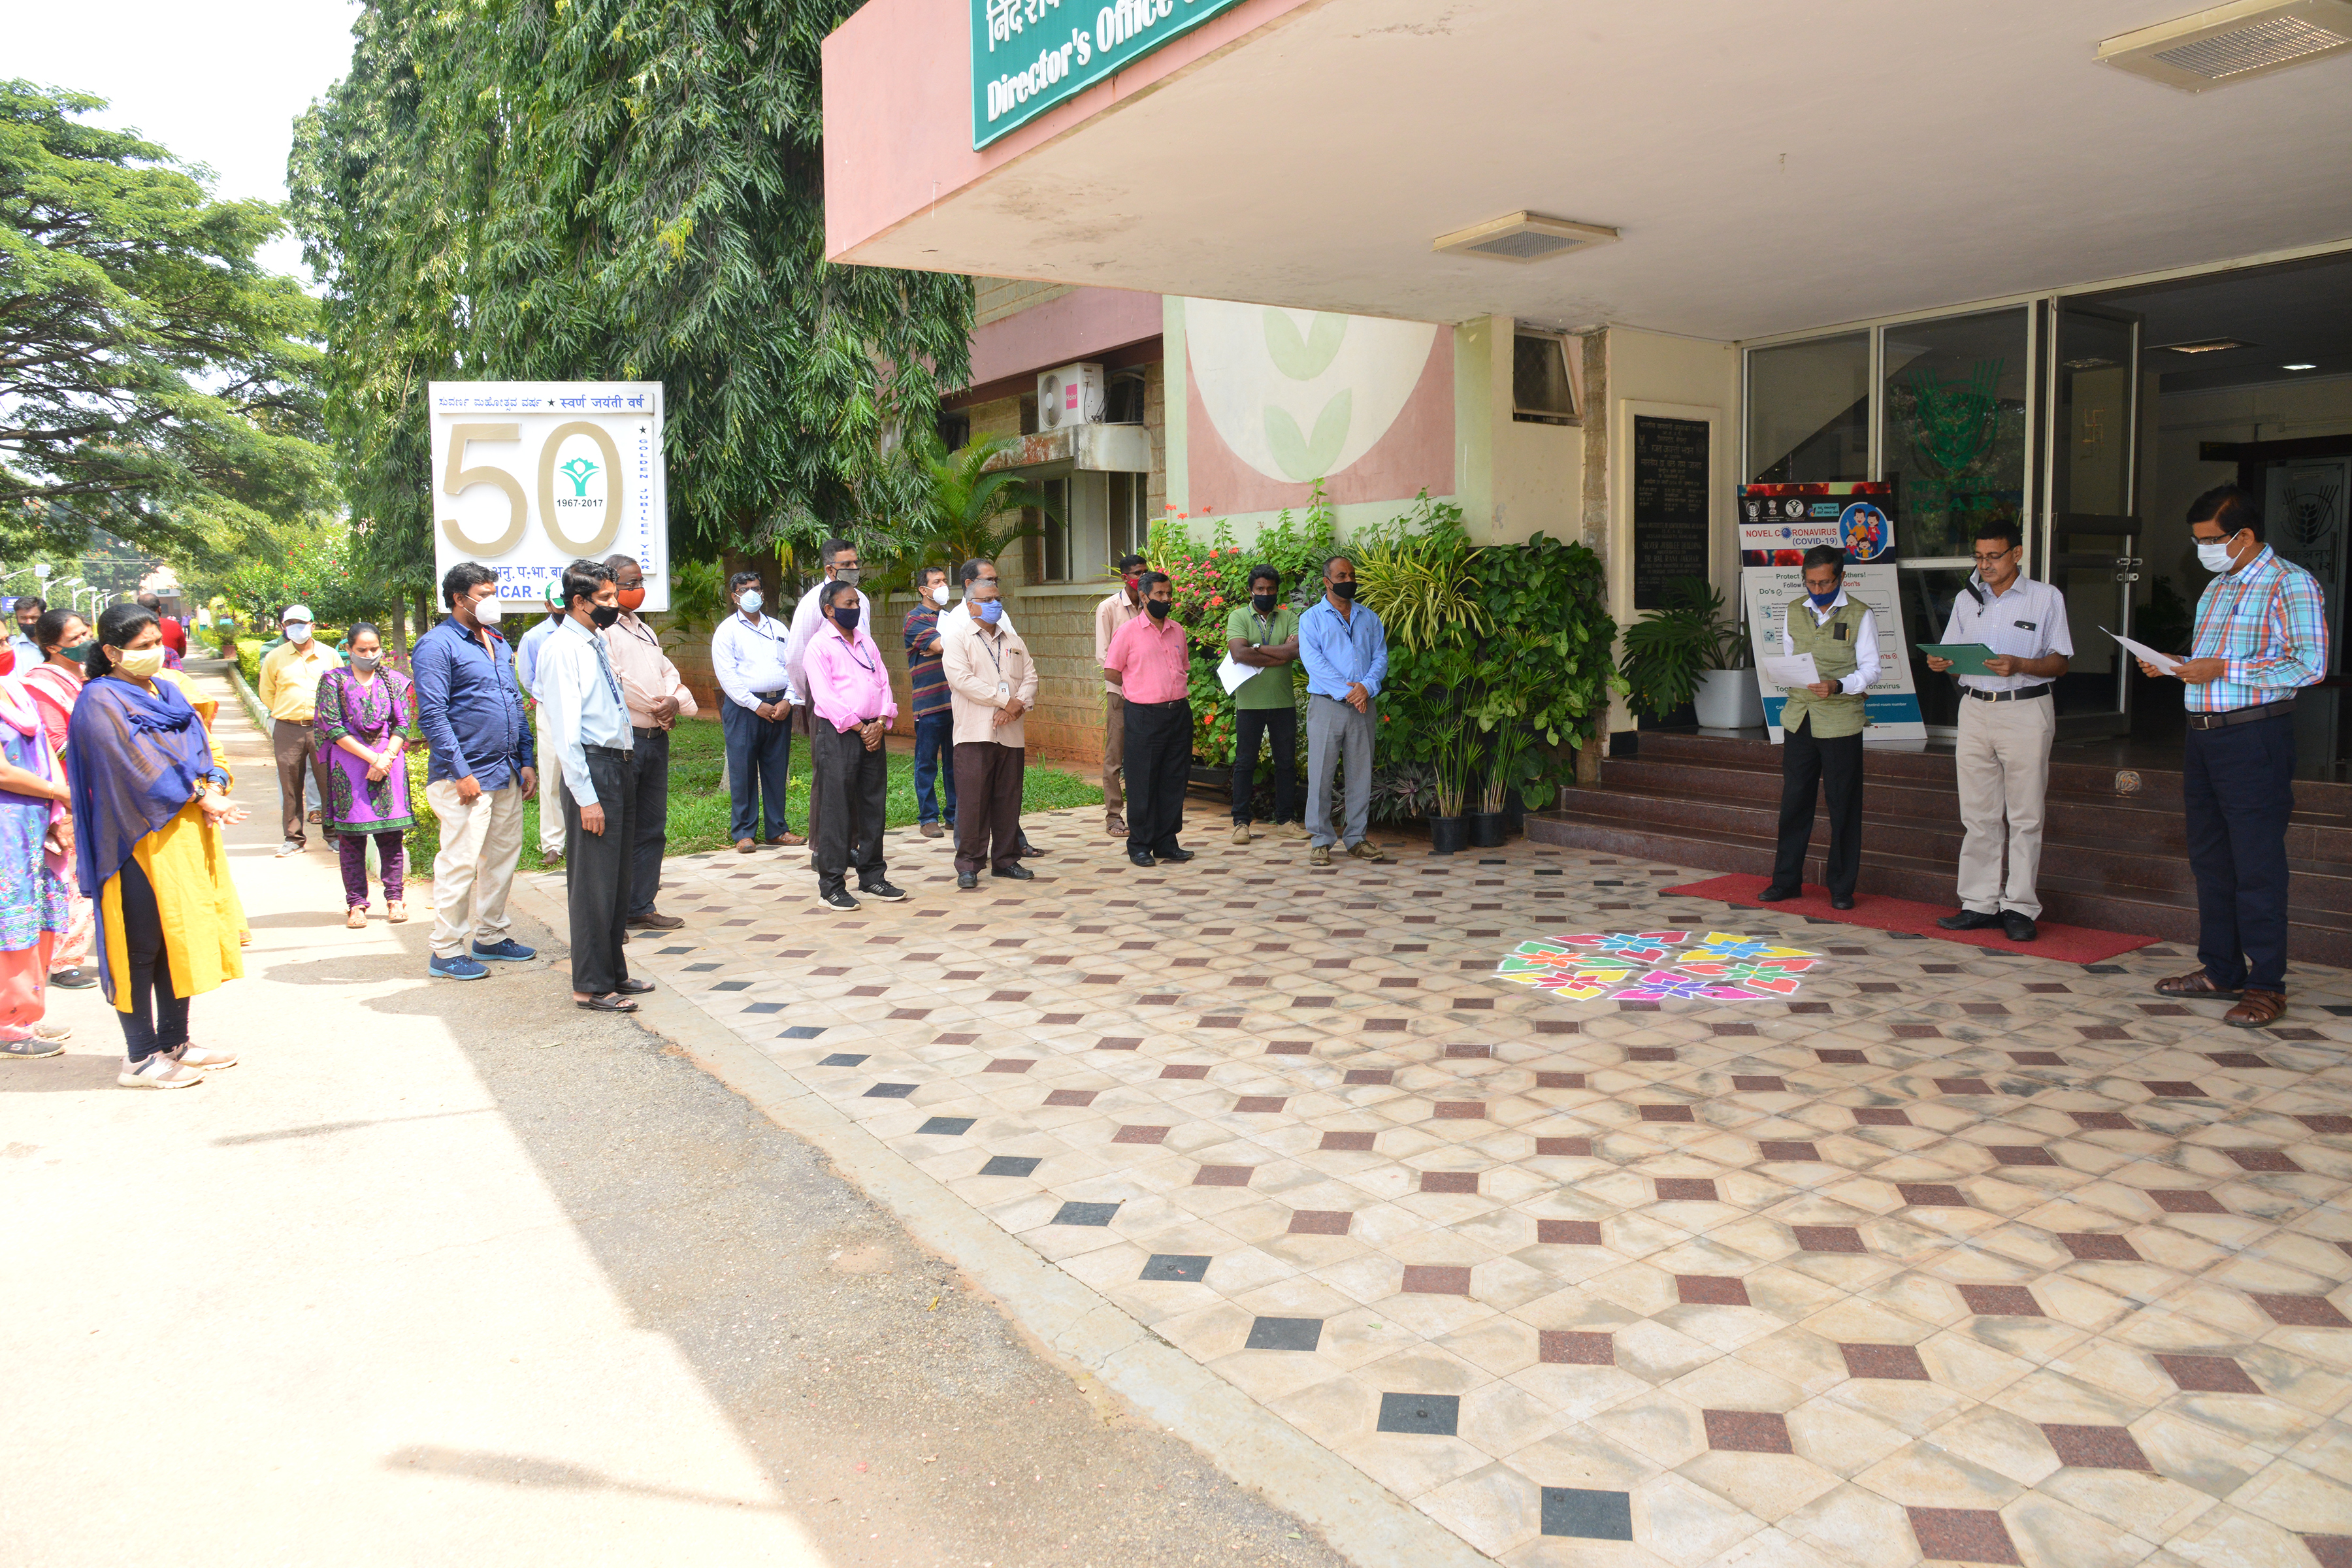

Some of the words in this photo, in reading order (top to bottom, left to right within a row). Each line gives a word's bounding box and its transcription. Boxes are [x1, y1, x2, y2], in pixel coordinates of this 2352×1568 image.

[987, 27, 1091, 123] Director's
[1096, 0, 1174, 53] Office
[559, 394, 587, 408] स्वर्ण
[591, 394, 623, 408] जयंती
[627, 394, 645, 408] वर्ष
[639, 439, 648, 478] GOLDEN
[441, 421, 623, 557] 50
[557, 499, 604, 508] 1967-2017
[640, 489, 649, 535] JUBILEE
[1910, 496, 1995, 514] ICAR
[1746, 529, 1773, 538] NOVEL
[1792, 538, 1838, 546] (COVID-19)
[640, 544, 650, 570] YEAR
